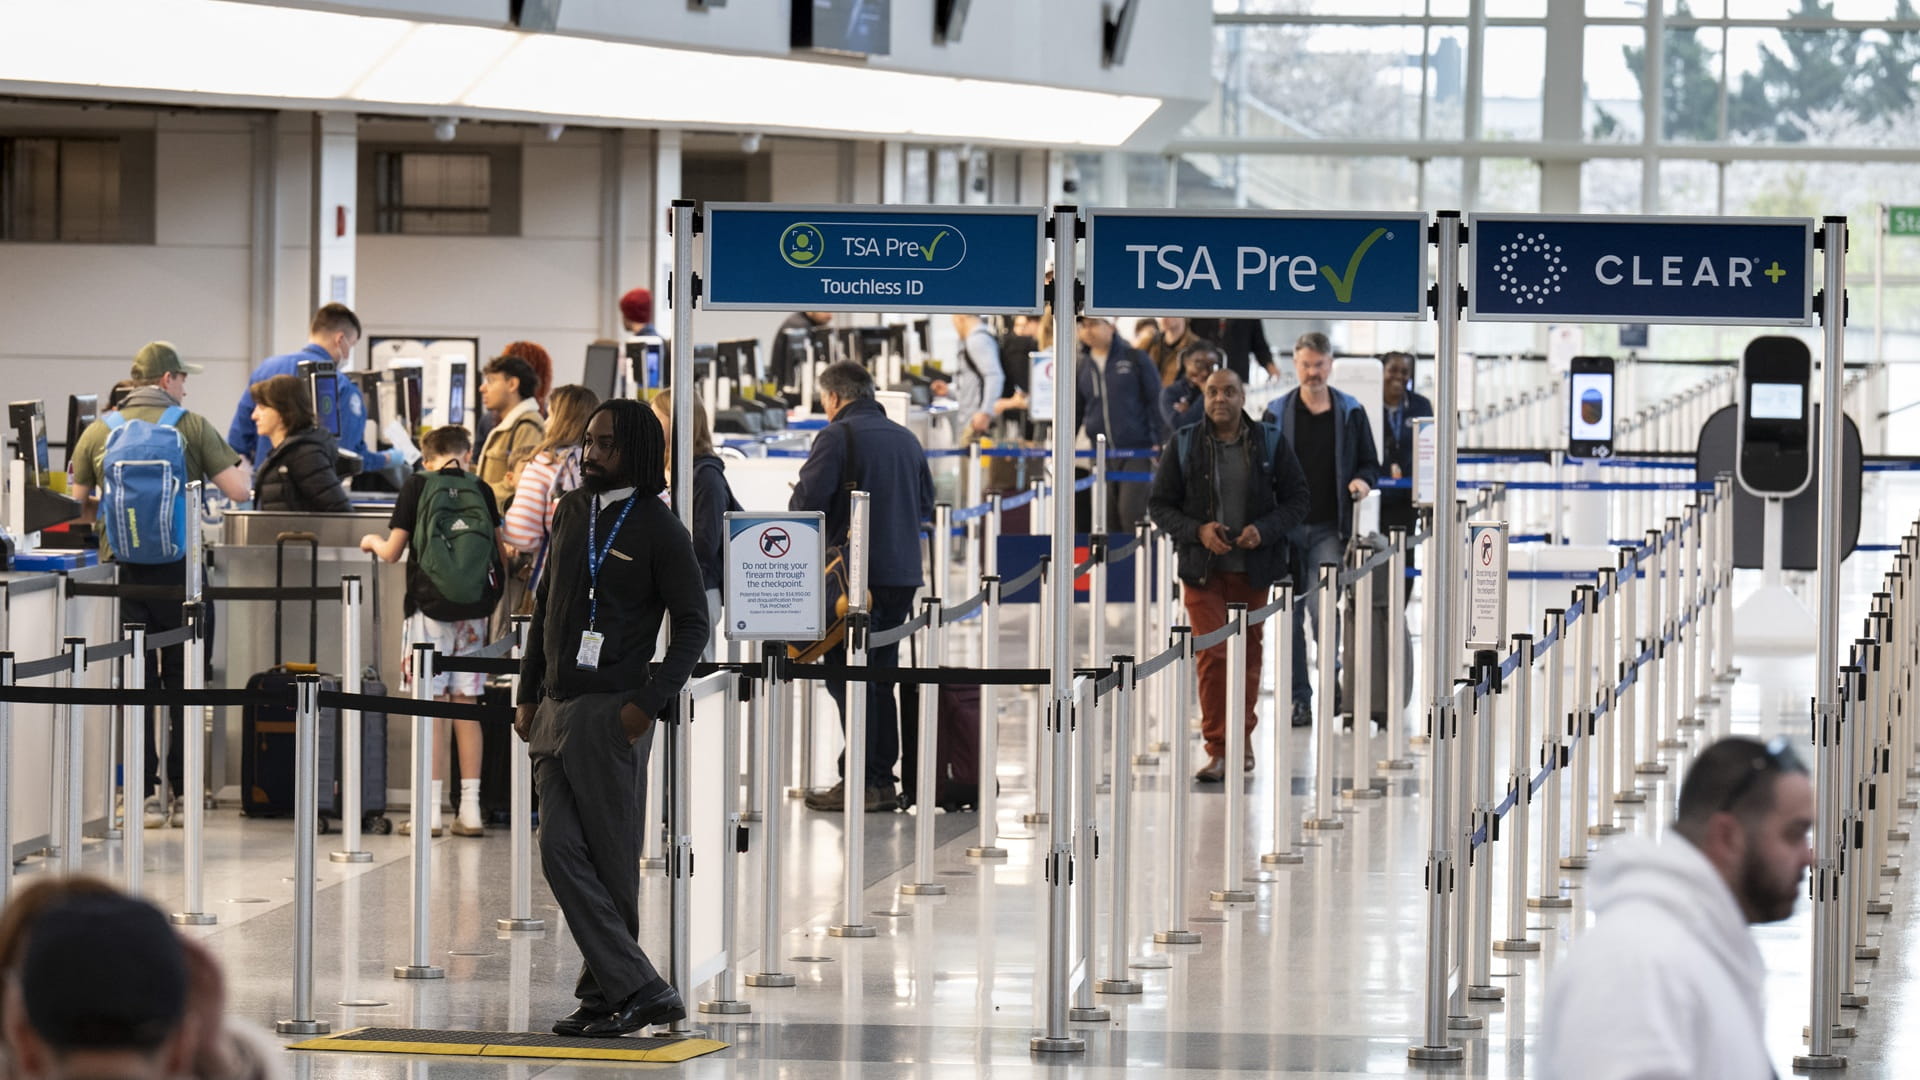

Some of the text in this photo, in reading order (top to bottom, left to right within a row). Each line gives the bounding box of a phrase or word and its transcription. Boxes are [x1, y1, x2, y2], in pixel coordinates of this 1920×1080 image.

[842, 237, 880, 257] TSA
[1125, 244, 1222, 290] TSA
[820, 278, 924, 295] Touchless ID
[742, 562, 808, 571] Do not bring your
[745, 571, 805, 580] firearm through
[747, 580, 804, 589] the checkpoint.
